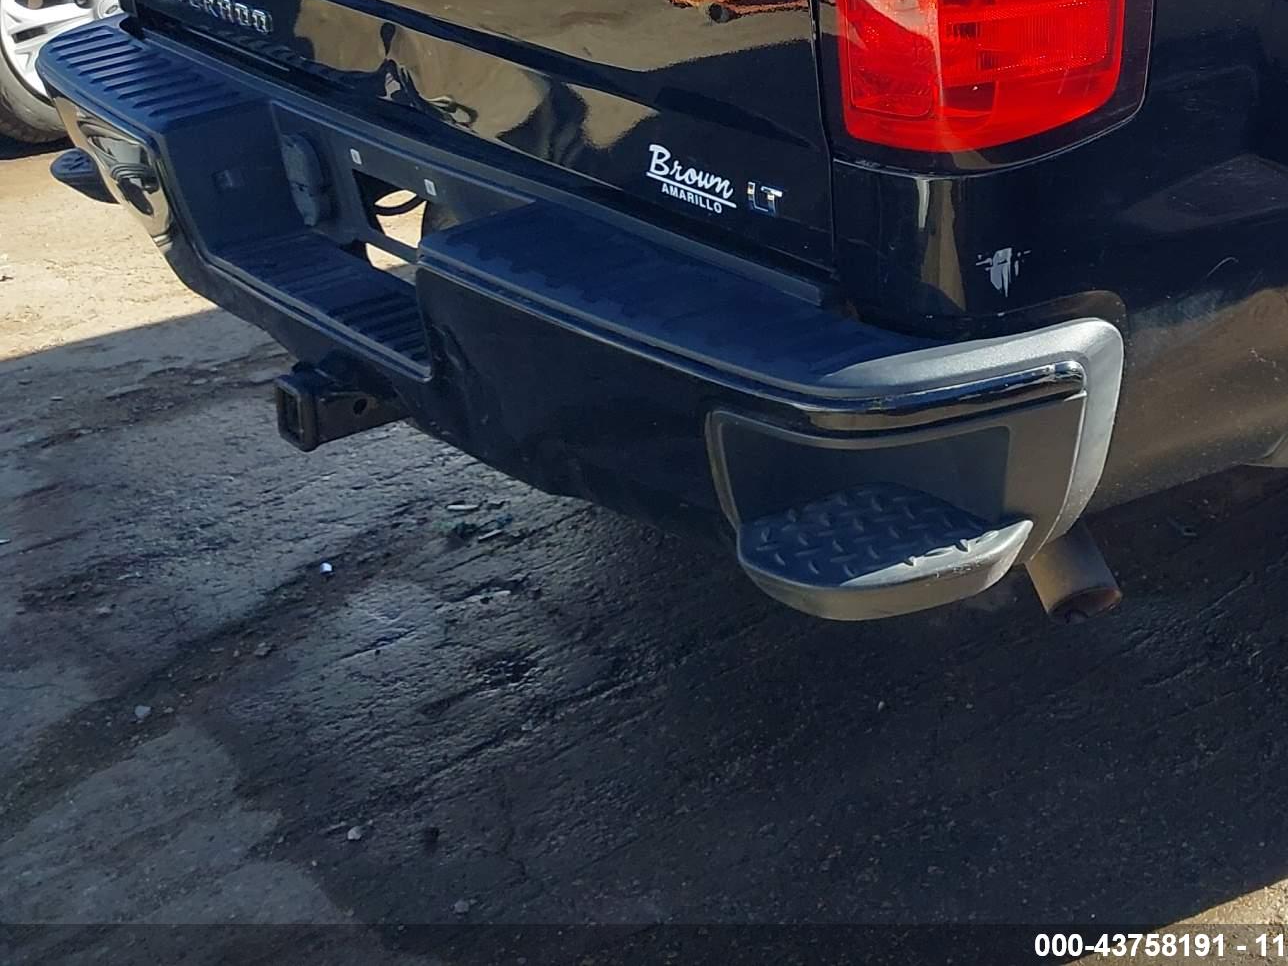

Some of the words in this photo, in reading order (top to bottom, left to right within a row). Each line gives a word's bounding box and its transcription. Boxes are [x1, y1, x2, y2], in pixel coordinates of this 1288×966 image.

[648, 143, 735, 201] Brown
[661, 183, 723, 214] AMARILLO
[746, 181, 785, 217] LT
